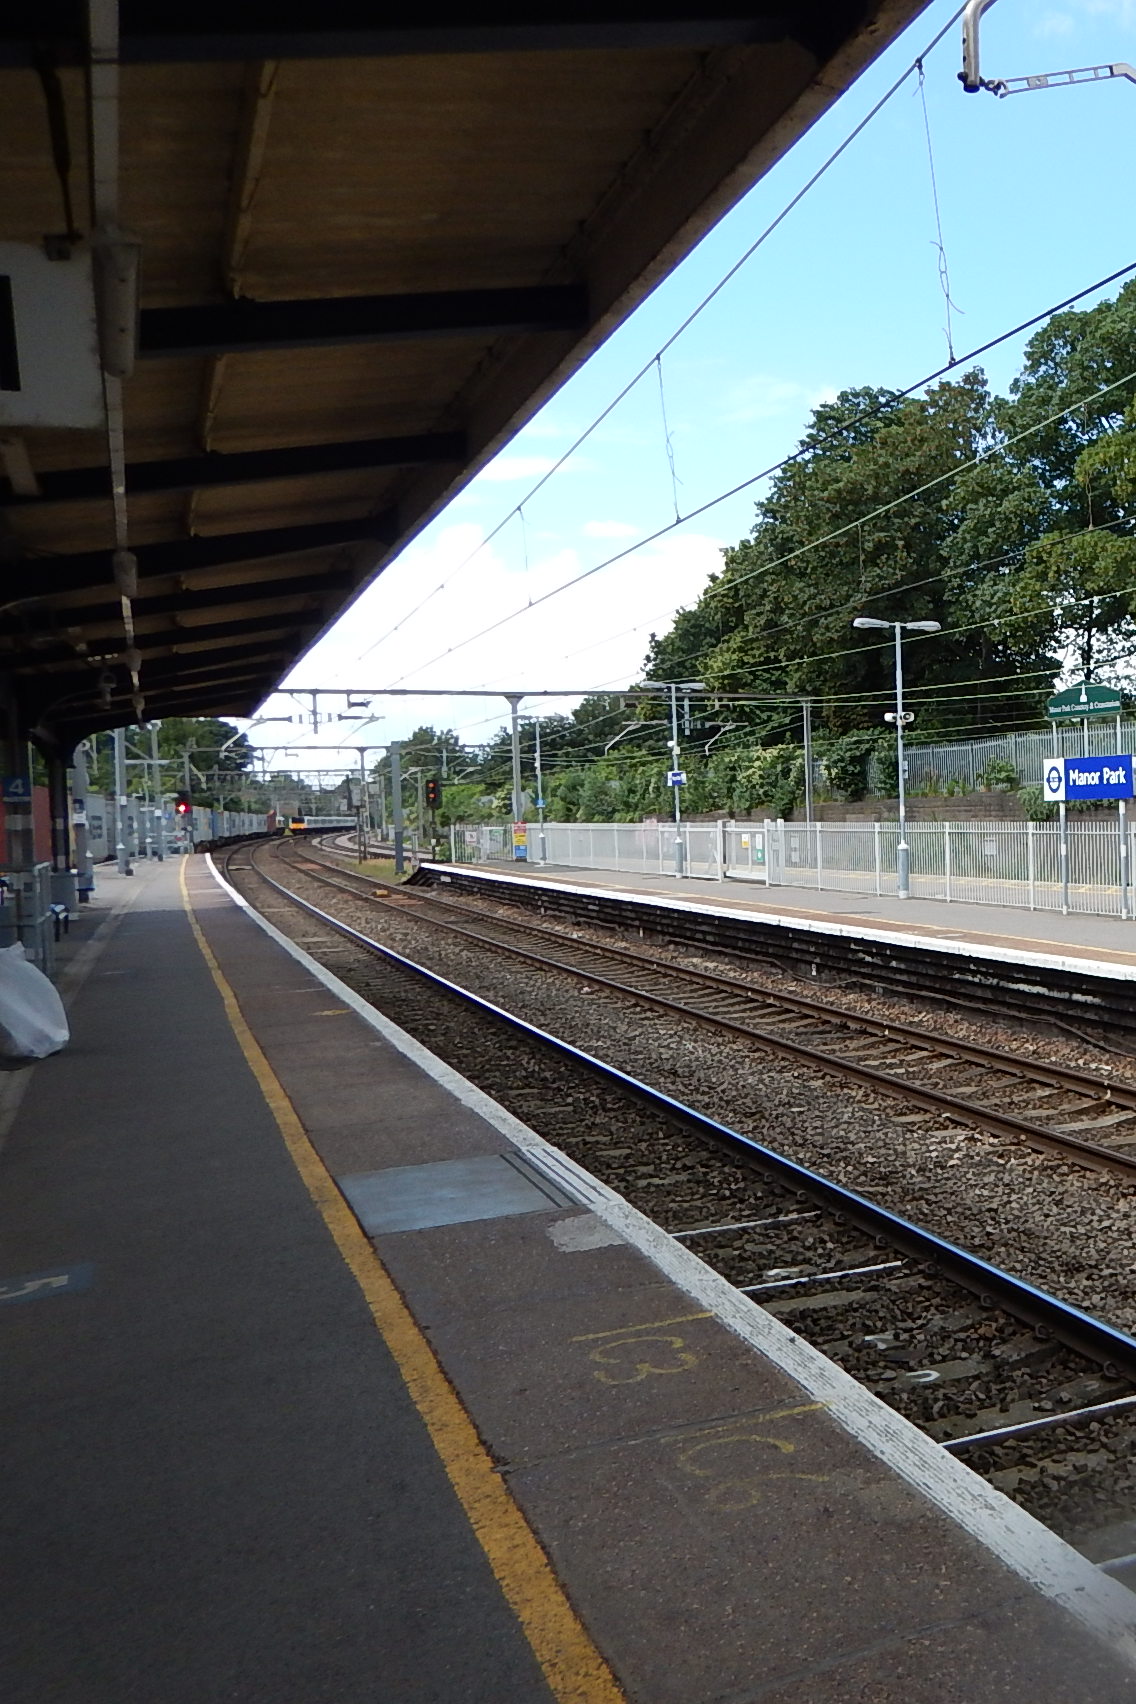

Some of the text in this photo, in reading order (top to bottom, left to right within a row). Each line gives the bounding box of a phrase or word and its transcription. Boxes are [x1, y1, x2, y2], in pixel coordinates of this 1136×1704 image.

[1069, 766, 1126, 786] Manor Park
[9, 778, 24, 794] 4
